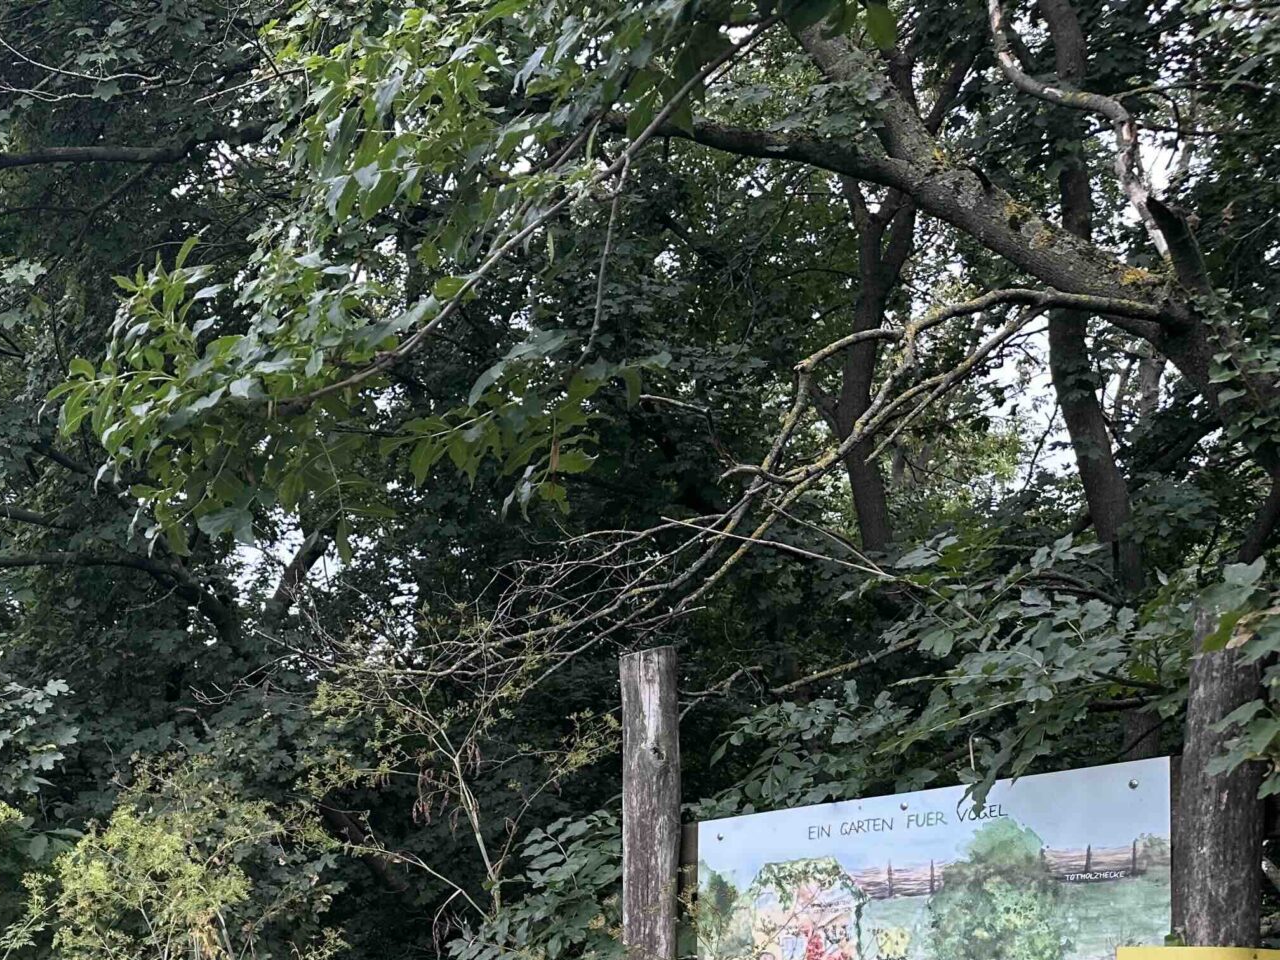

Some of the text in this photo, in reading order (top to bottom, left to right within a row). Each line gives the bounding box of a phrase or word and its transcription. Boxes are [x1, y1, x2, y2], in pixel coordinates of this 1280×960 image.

[808, 825, 831, 840] EIN
[840, 817, 894, 836] GARTEN
[906, 811, 948, 829] FUER
[1064, 870, 1126, 881] TOTHOLZHECKE
